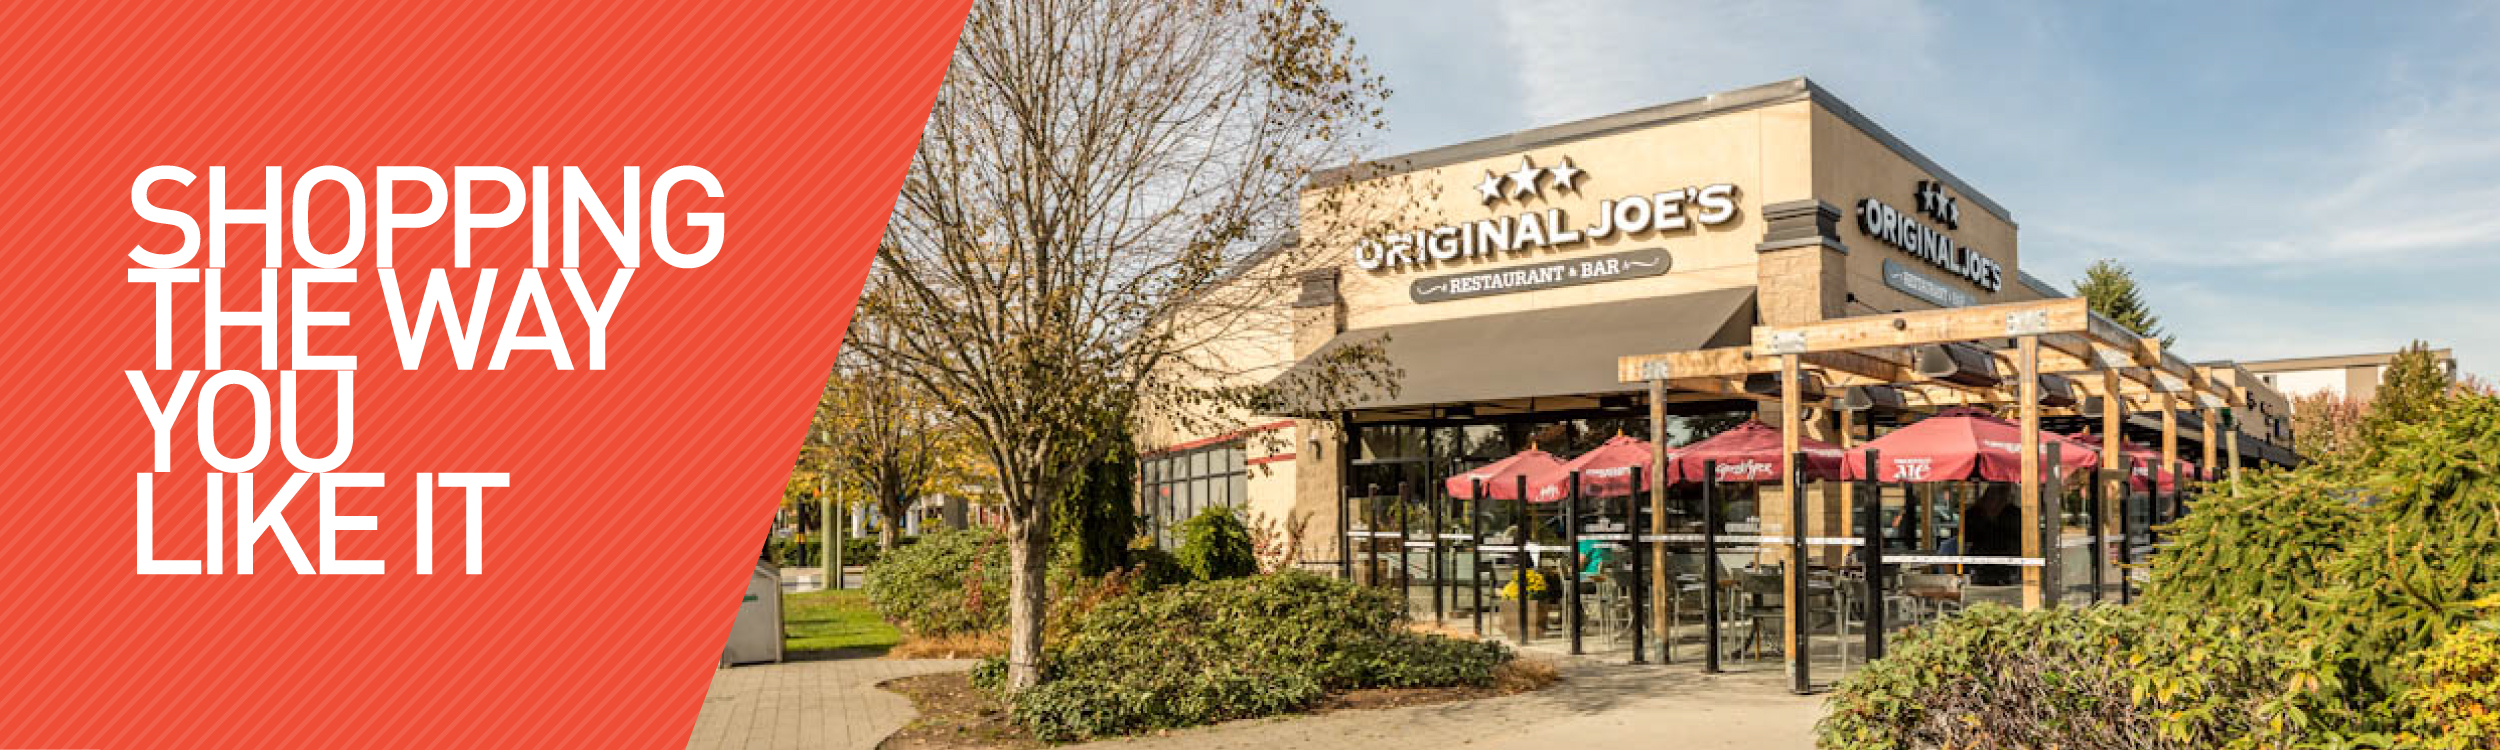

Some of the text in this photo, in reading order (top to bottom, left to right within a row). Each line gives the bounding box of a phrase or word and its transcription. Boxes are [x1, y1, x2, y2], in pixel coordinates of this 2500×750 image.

[1355, 183, 1735, 270] ORIGINAL JOE'S
[1865, 198, 1960, 272] ORIGINAL
[1450, 264, 1565, 294] RESTAURANT
[1580, 257, 1620, 279] BAR
